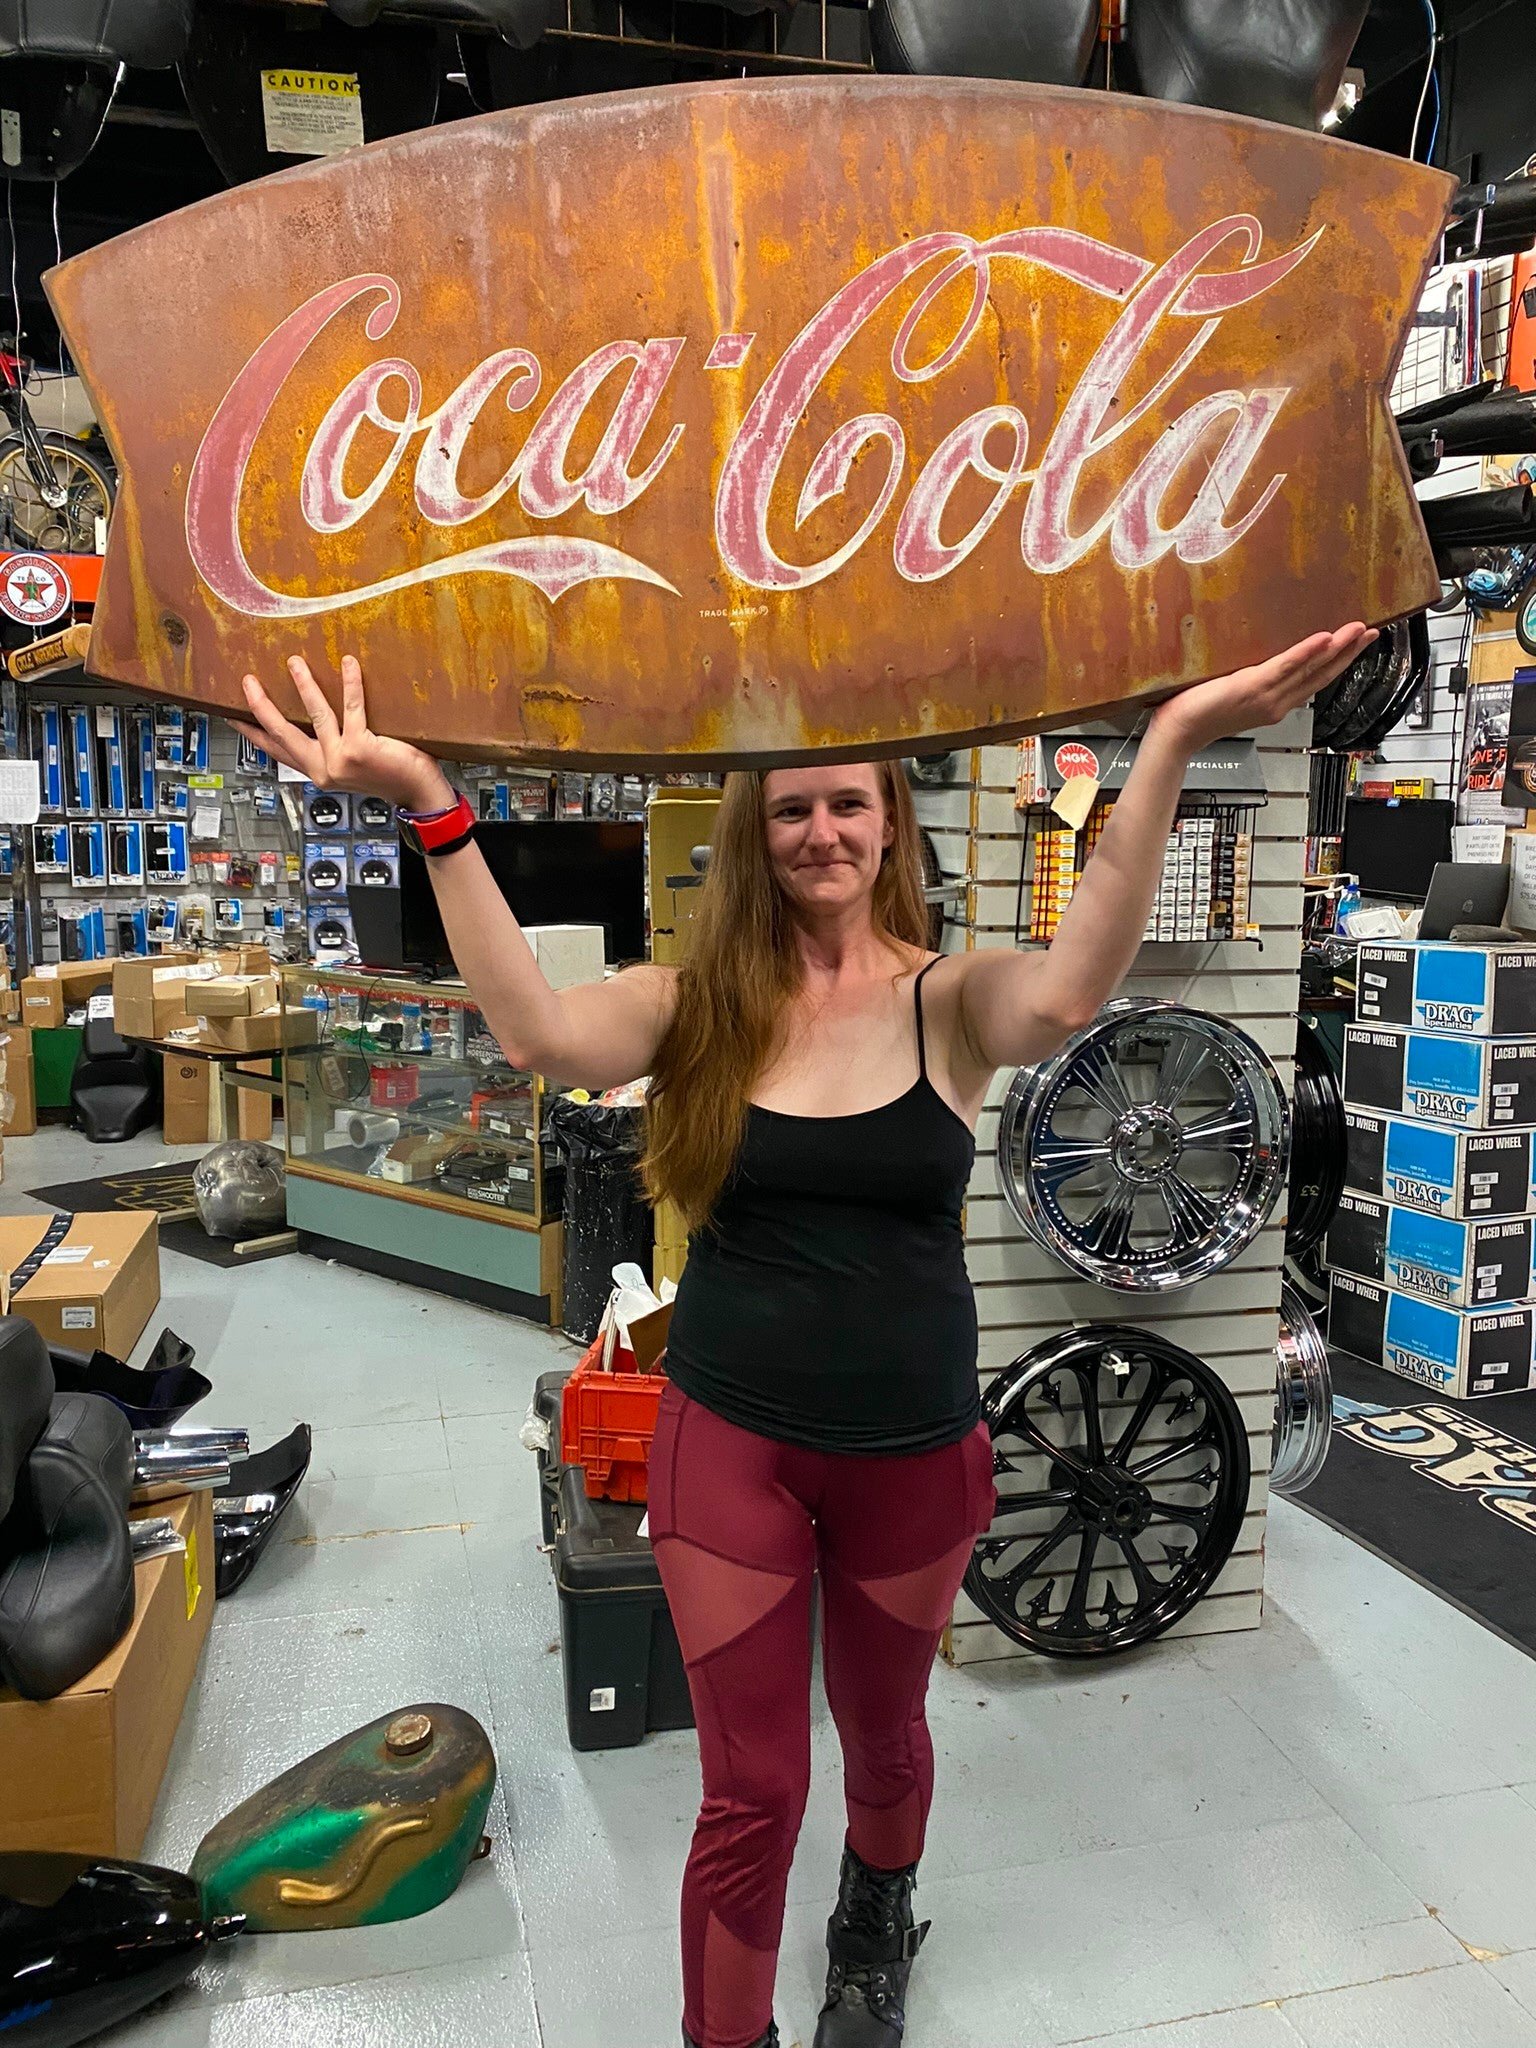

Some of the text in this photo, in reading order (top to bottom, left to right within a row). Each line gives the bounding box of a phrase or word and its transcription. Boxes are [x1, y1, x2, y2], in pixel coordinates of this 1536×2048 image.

[267, 75, 354, 92] CAUTION
[185, 213, 1327, 618] Coca-Cola
[699, 609, 728, 618] TRADE
[1061, 752, 1090, 764] NGK
[1112, 761, 1239, 770] THE PECIALIST
[1361, 949, 1408, 963] LACED WHEEL
[1497, 955, 1536, 968] LACED WH
[1424, 1003, 1473, 1024] DRAG
[1424, 1018, 1473, 1031] Specialties
[1348, 1030, 1398, 1048] LACED WHEEL
[1494, 1046, 1536, 1060] LACED WHE
[1415, 1091, 1467, 1115] DRAG
[1415, 1106, 1467, 1121] Specialties
[1344, 1115, 1379, 1133] ED WHEEL
[1468, 1136, 1522, 1152] LACED WHEEL
[477, 1189, 506, 1202] SHOOTER
[1394, 1176, 1442, 1205] DRAG
[1338, 1196, 1380, 1218] CED WHEEL
[1394, 1191, 1442, 1212] Specialties
[1477, 1222, 1526, 1241] LACED WHEEL
[1398, 1263, 1450, 1294] DRAG
[1333, 1274, 1381, 1302] LACED WHEEL
[1472, 1313, 1525, 1332] LACED WHEEL
[1394, 1348, 1445, 1382] DRAG
